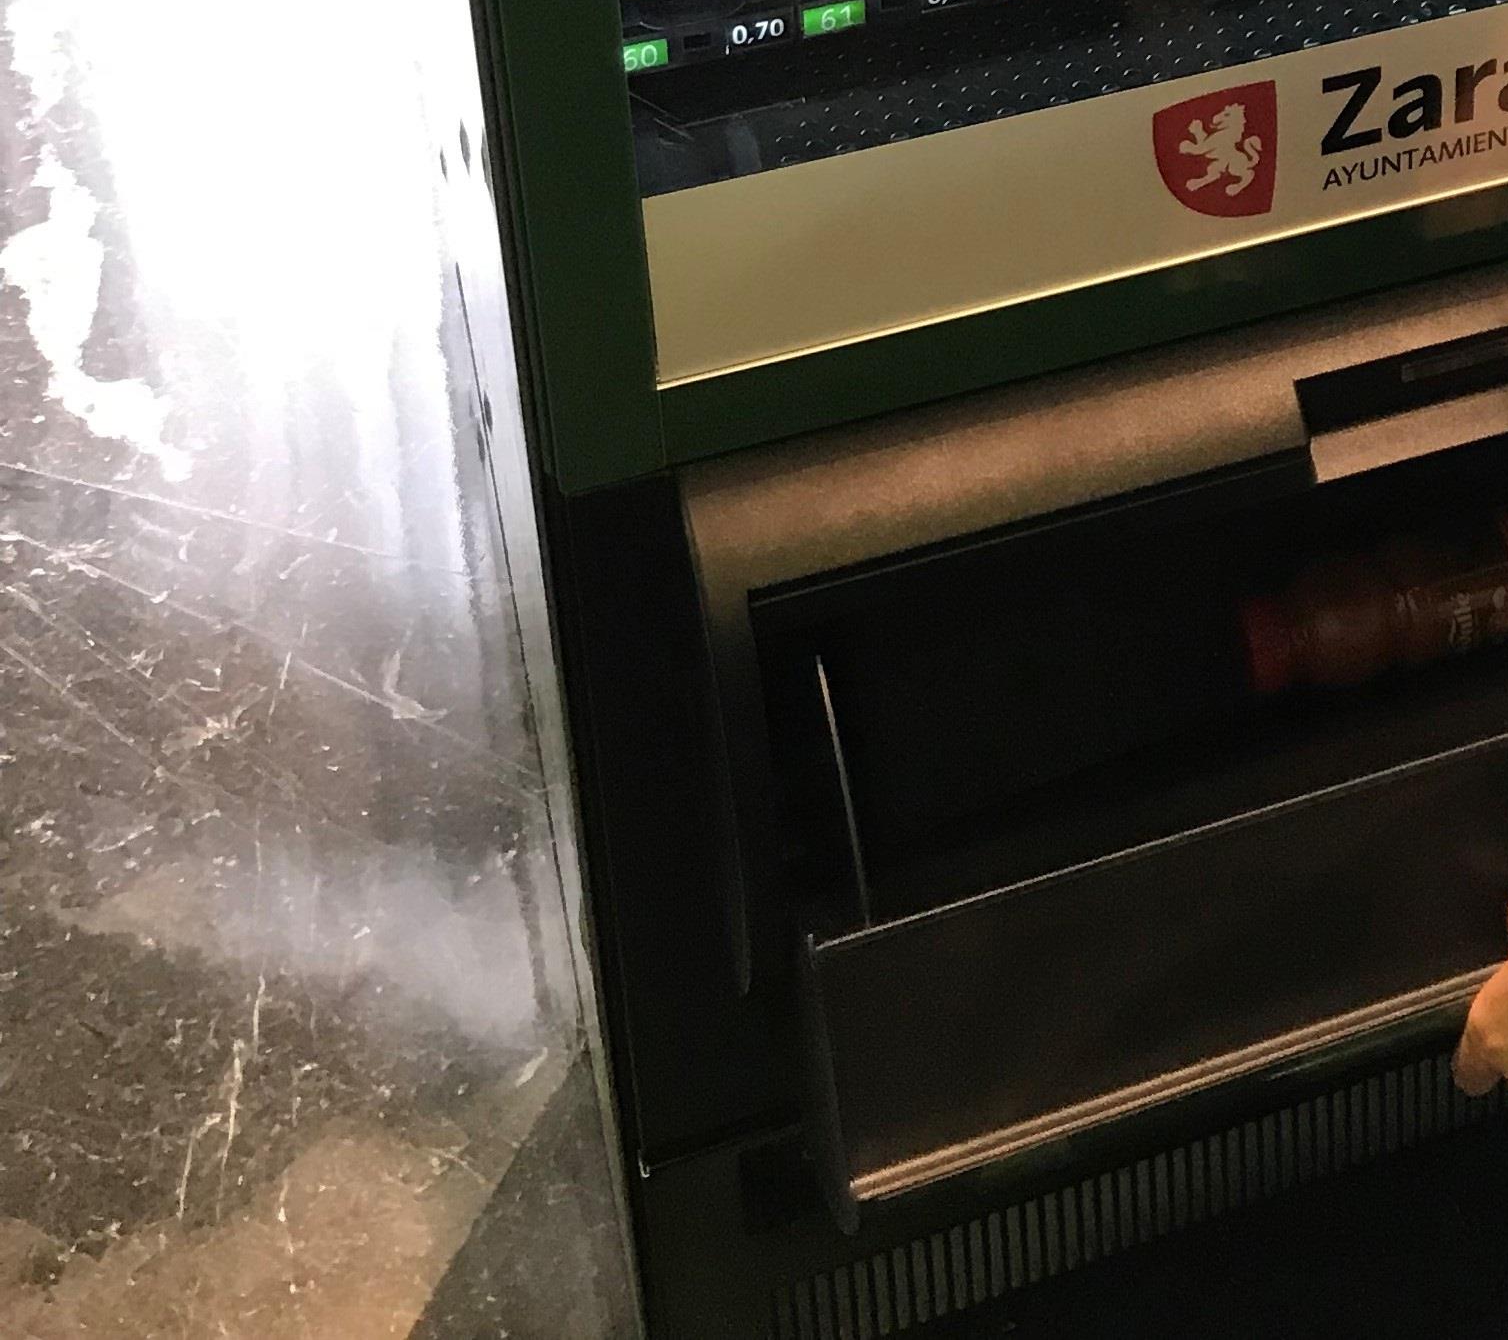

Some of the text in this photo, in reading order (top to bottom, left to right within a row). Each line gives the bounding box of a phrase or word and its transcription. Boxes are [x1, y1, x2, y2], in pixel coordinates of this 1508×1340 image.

[820, 6, 853, 30] 61
[731, 19, 785, 46] 0,70
[624, 44, 658, 70] 60
